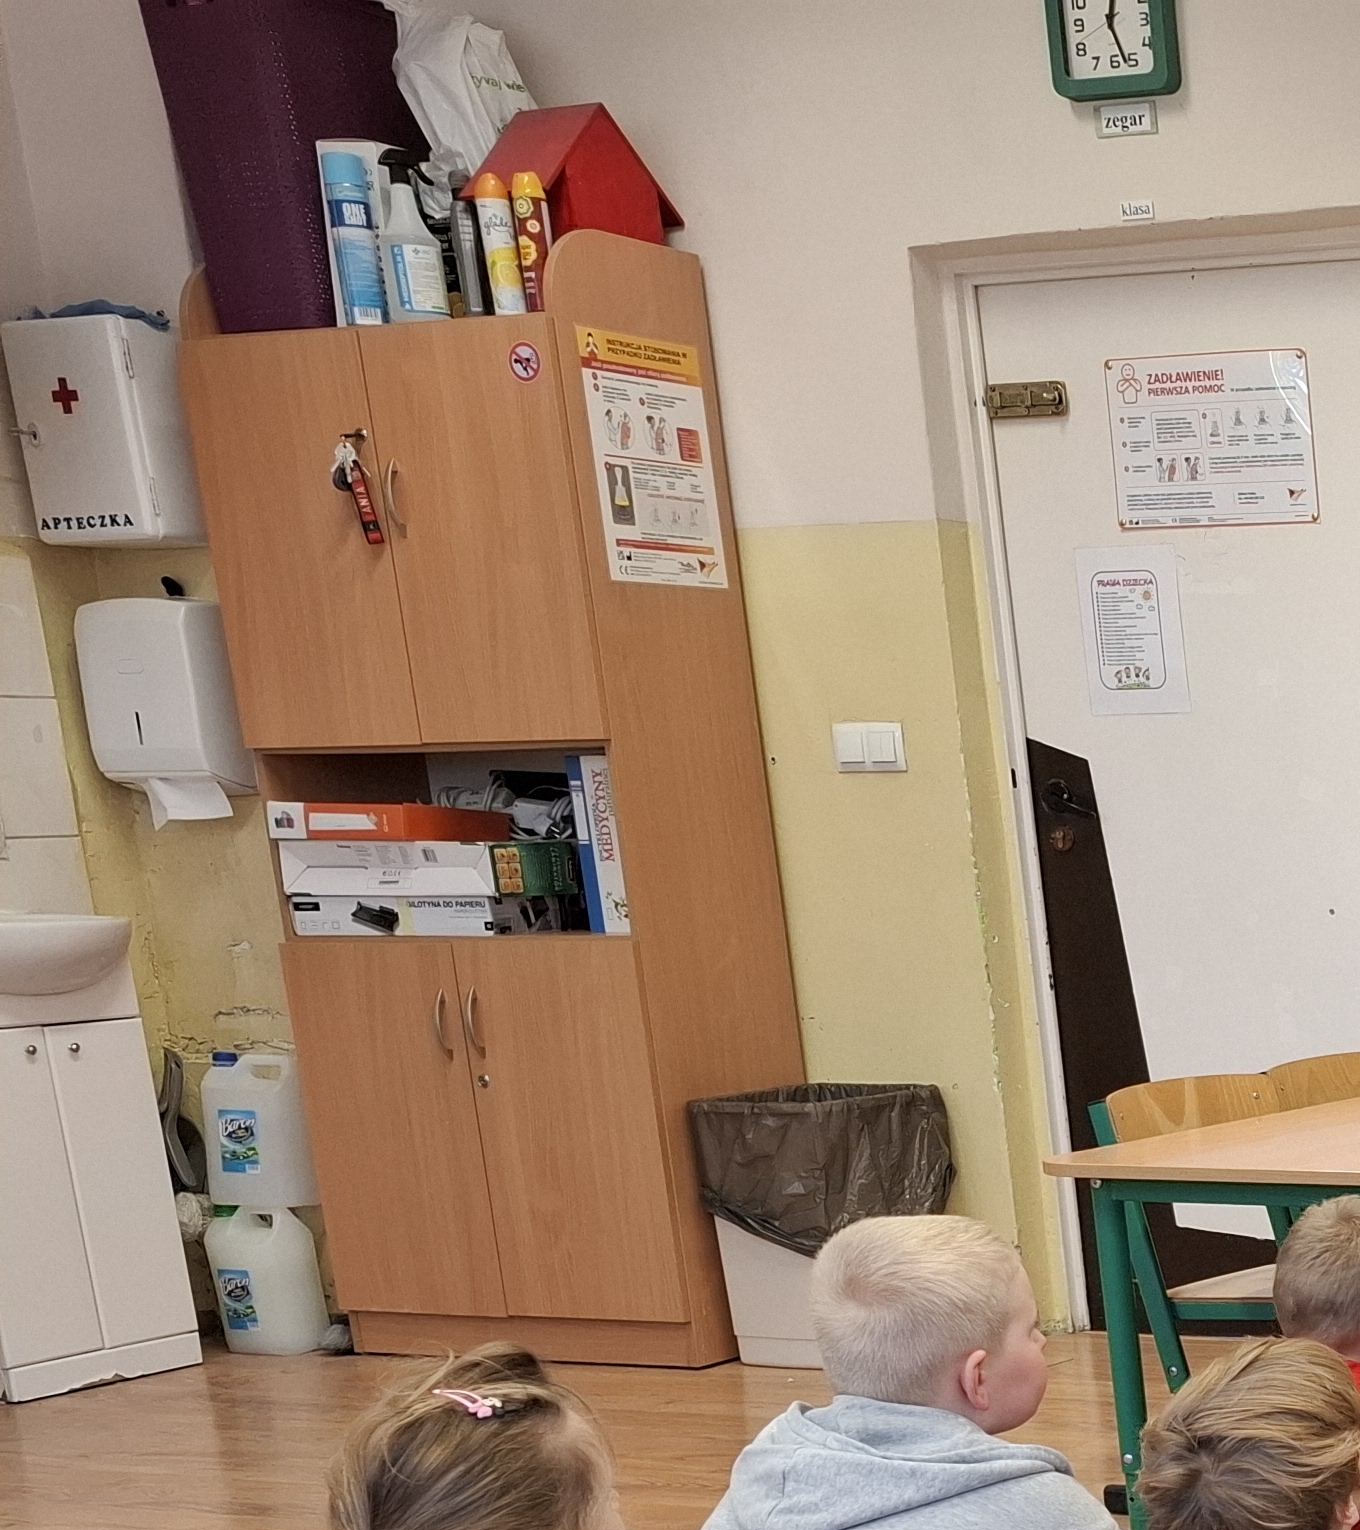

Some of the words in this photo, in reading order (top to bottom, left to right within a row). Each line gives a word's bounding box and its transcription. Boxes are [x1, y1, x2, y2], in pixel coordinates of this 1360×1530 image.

[1073, 18, 1085, 33] 9
[1139, 12, 1150, 27] 3
[1075, 42, 1087, 57] 8
[1141, 36, 1152, 50] 4
[1092, 56, 1101, 71] 7
[1109, 54, 1121, 69] 6
[1127, 52, 1139, 67] 5
[1104, 114, 1145, 132] zegar
[342, 202, 365, 215] ONE
[1121, 202, 1151, 216] klasa
[484, 216, 513, 236] glade
[1147, 368, 1224, 385] ZADŁAWIENIE!
[1148, 386, 1190, 397] PIERWSZA
[1192, 384, 1225, 394] POMOC
[355, 486, 372, 513] ANIA
[40, 513, 135, 532] APTECZKA
[591, 768, 616, 862] MEDYCYNY
[219, 1117, 256, 1137] Baron
[220, 1275, 250, 1296] Baron
